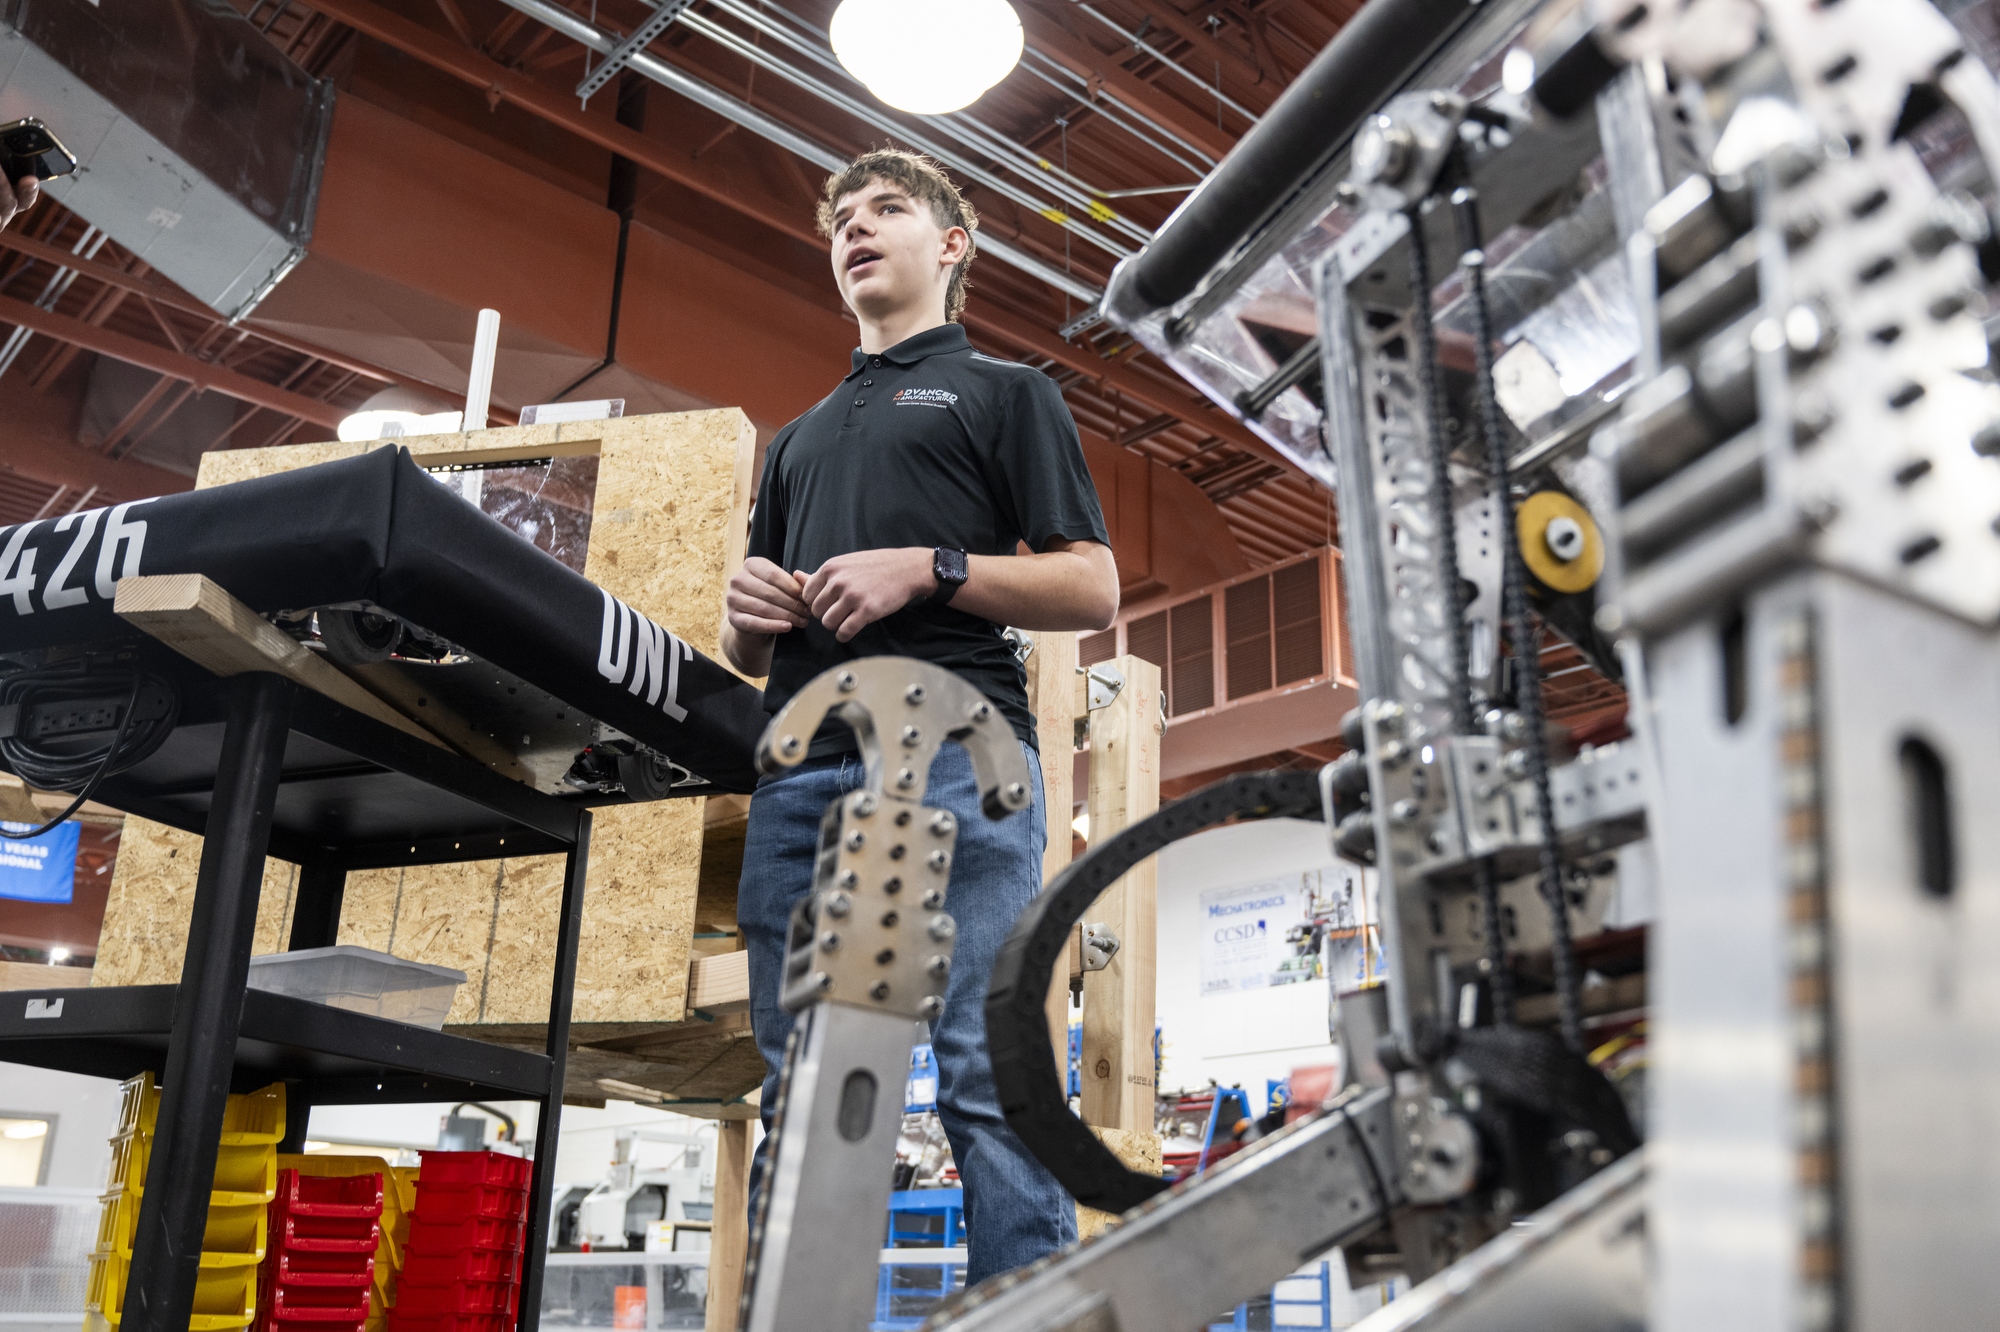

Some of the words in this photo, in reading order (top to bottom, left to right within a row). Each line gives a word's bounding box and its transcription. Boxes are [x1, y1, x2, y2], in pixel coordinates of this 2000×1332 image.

[892, 395, 955, 405] MANUFACTURING
[895, 388, 958, 402] ADVANCED
[4, 841, 49, 858] VEGAS
[1213, 923, 1256, 944] CCSD
